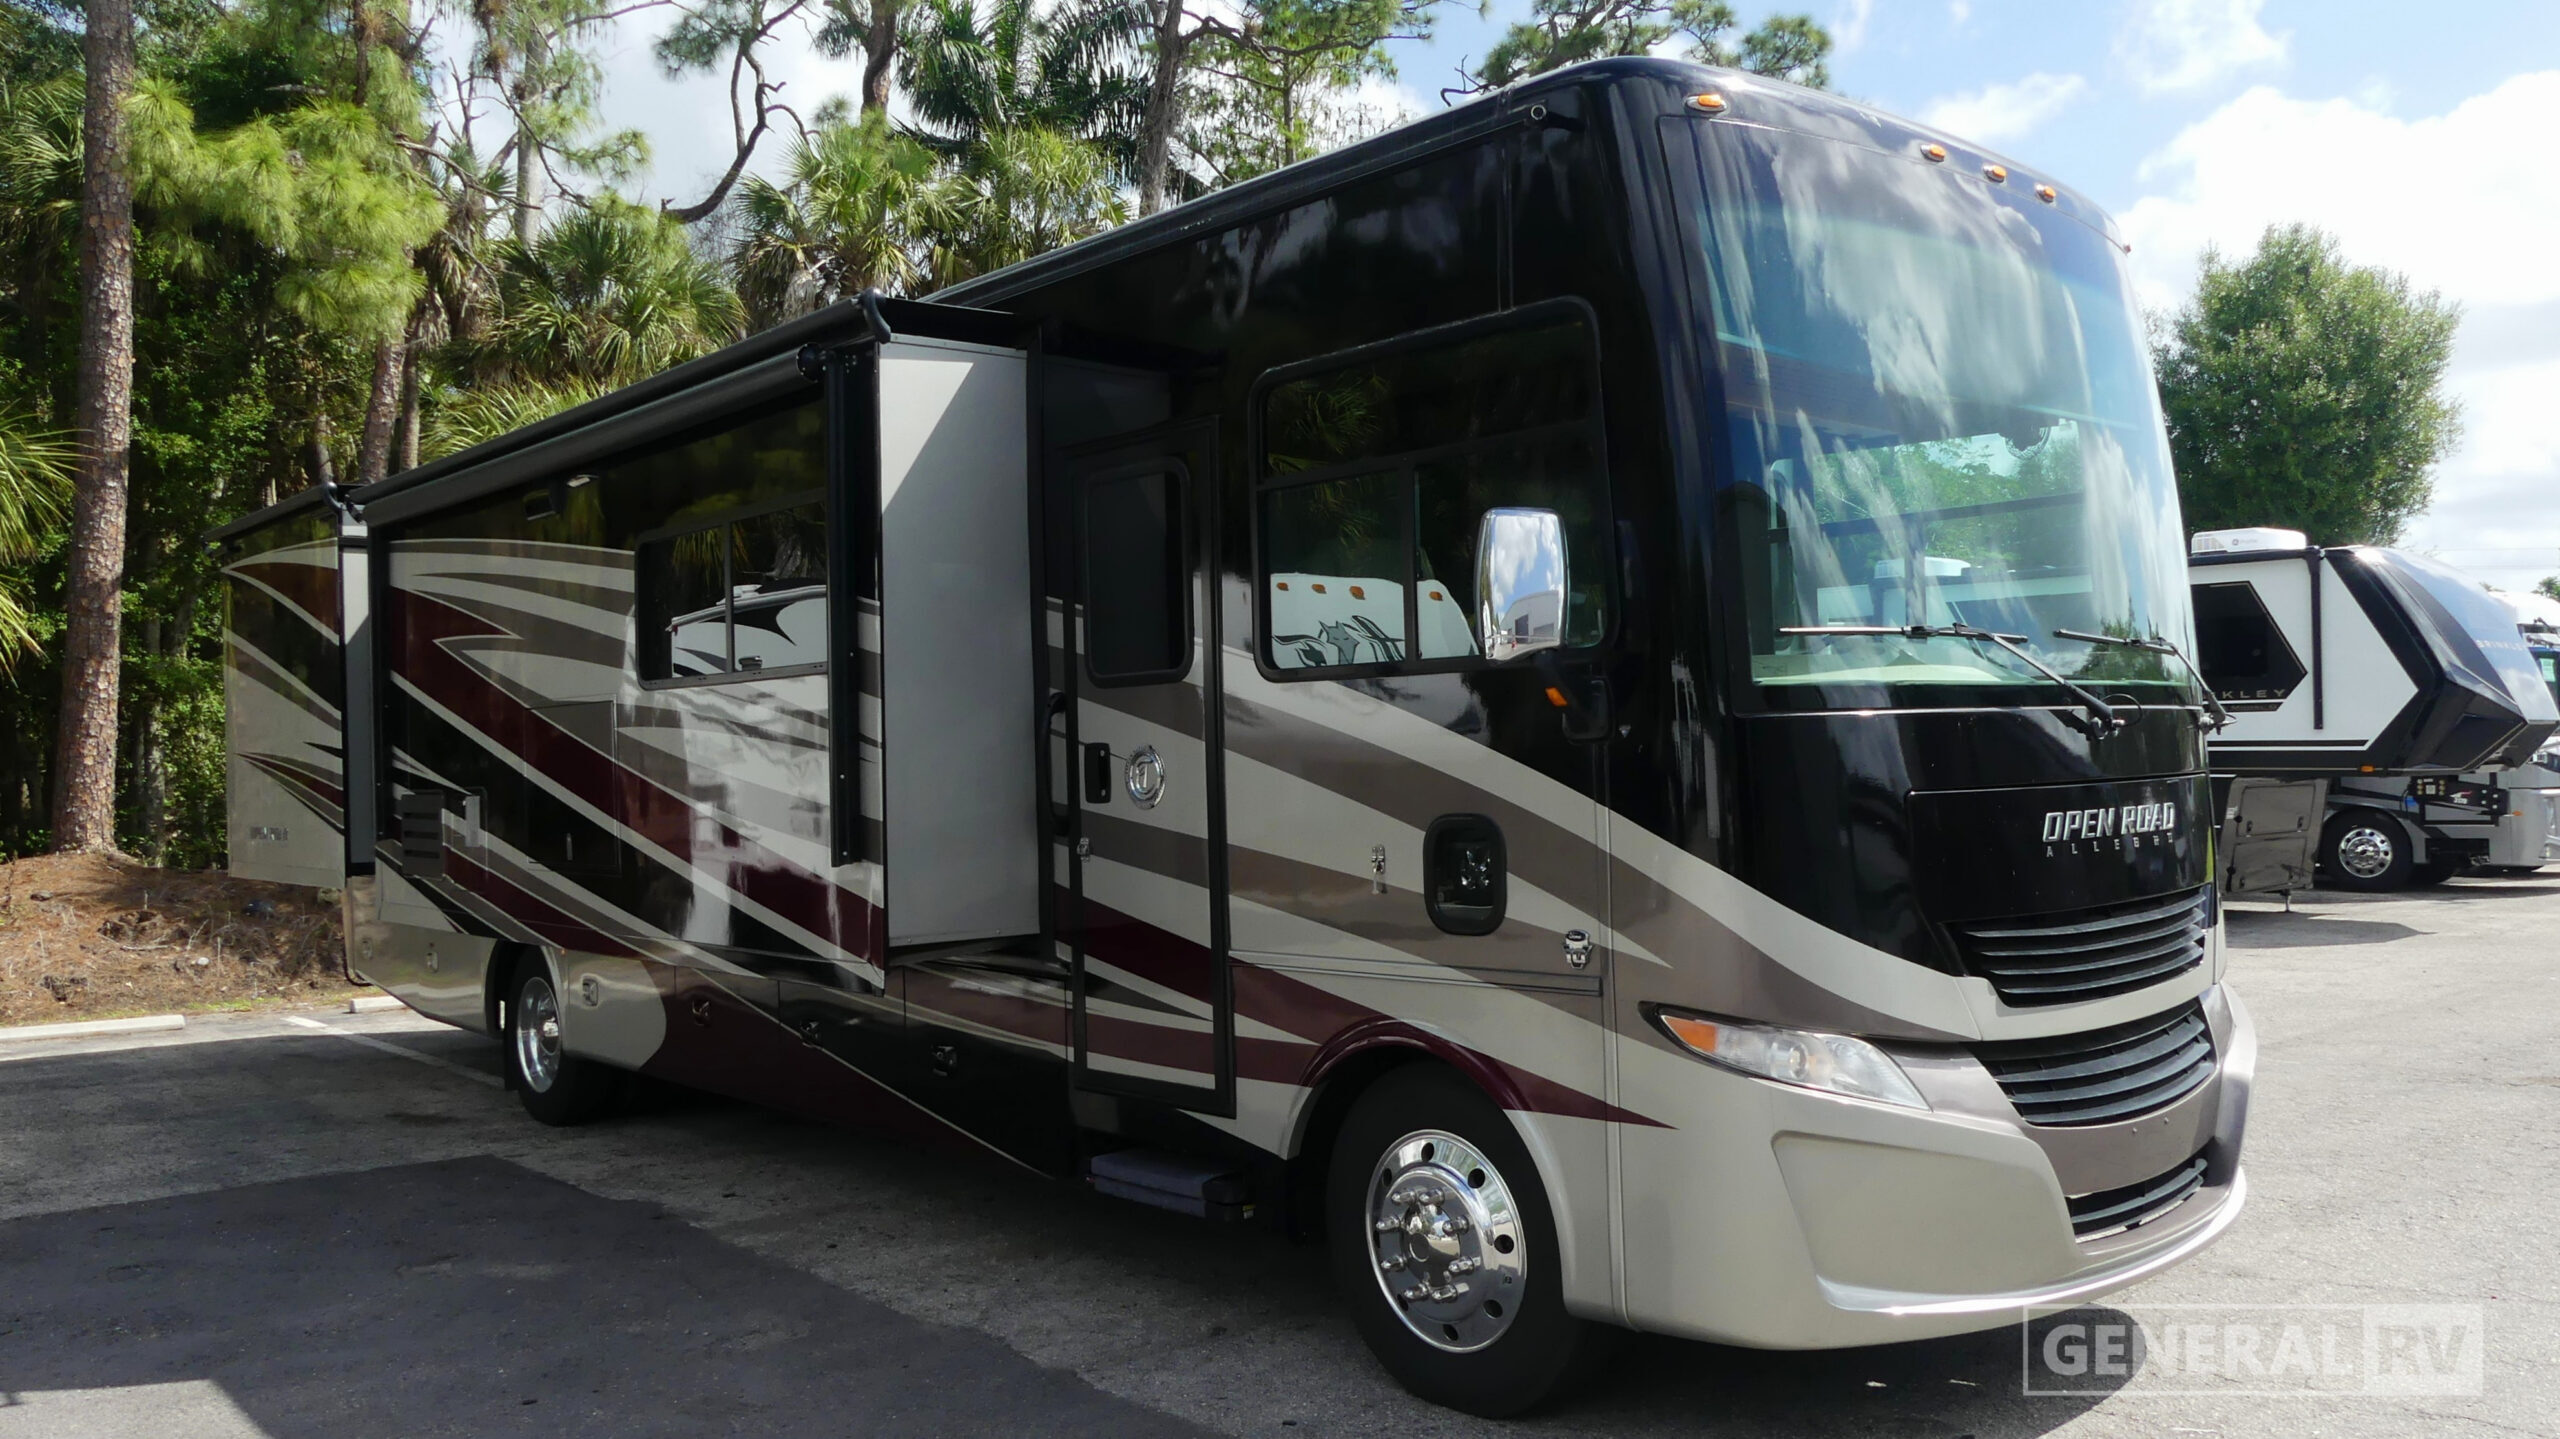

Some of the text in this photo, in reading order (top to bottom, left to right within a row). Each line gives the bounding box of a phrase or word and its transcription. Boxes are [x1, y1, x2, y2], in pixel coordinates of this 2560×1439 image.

[2044, 803, 2175, 842] OPEN ROAD
[2046, 832, 2174, 857] ALLEGRO
